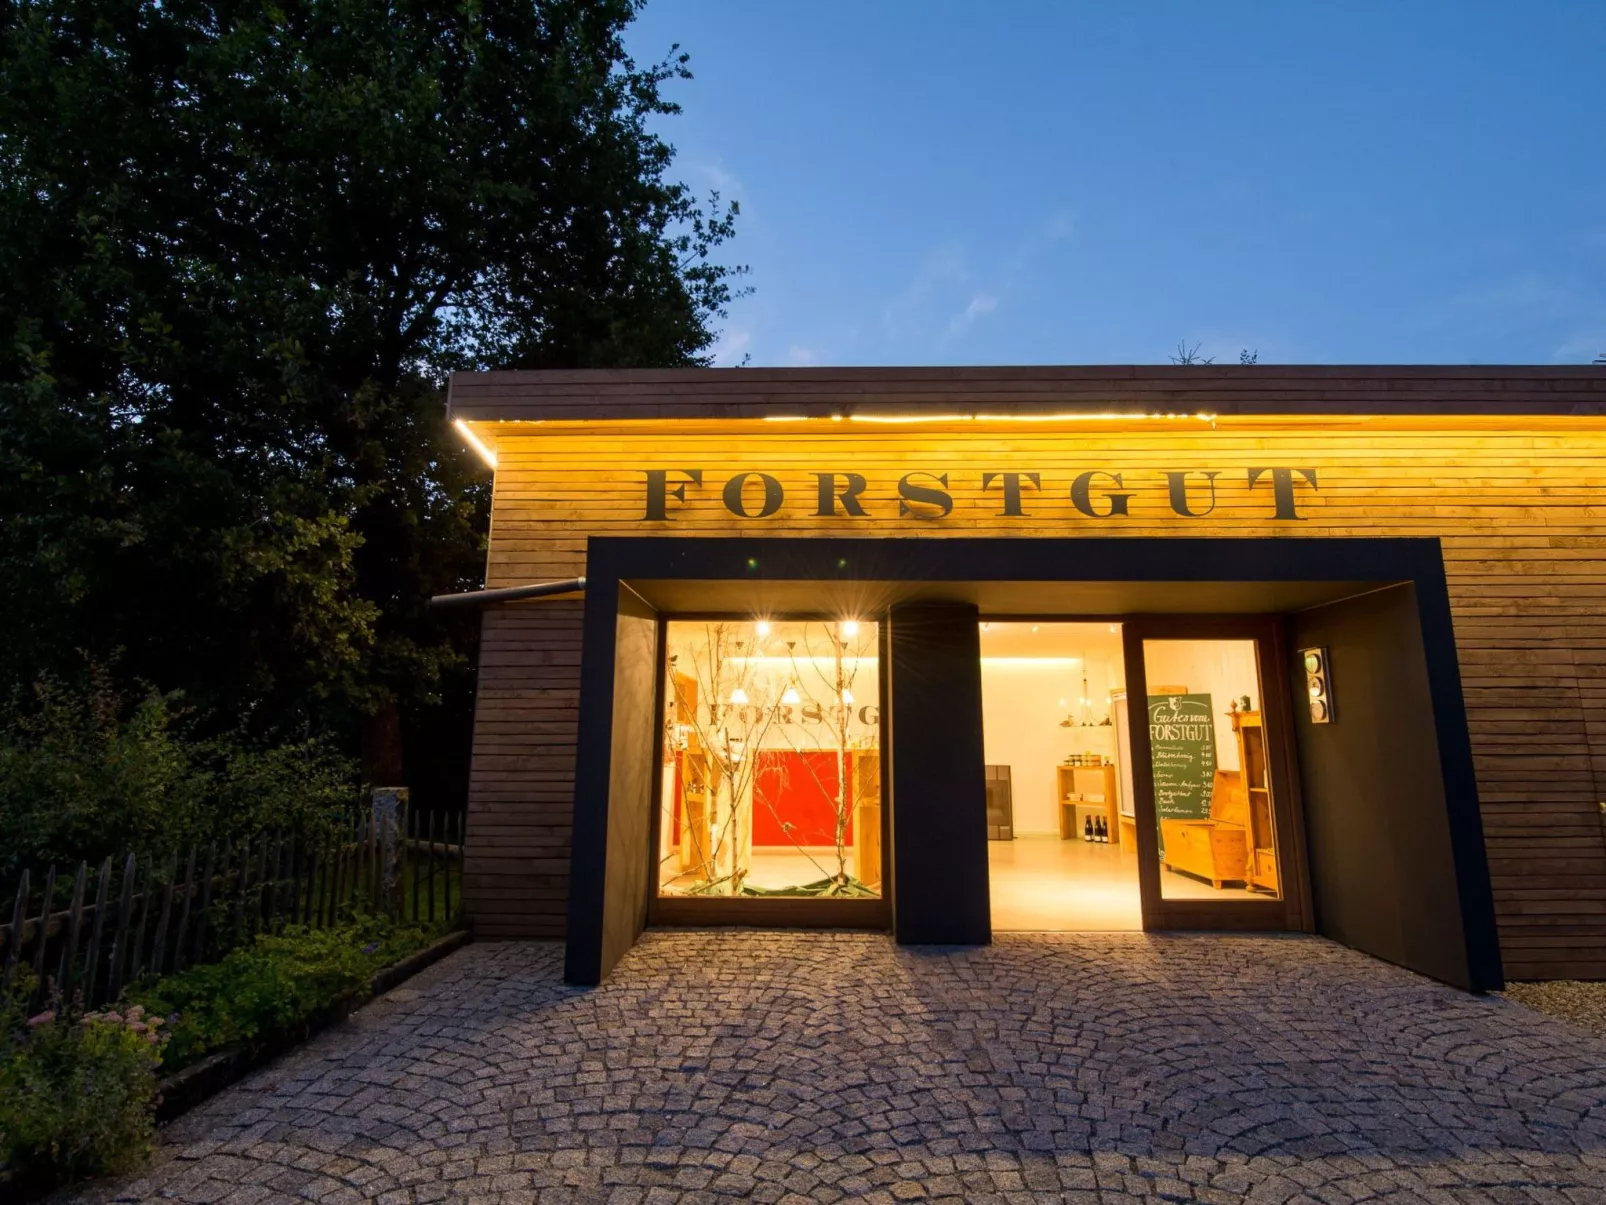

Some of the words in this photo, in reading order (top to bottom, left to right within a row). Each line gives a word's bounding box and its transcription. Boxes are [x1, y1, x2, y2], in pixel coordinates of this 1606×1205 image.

[643, 467, 1317, 521] FORSTGUT
[1153, 706, 1189, 723] Gutes
[1190, 714, 1210, 723] vom
[1150, 723, 1212, 741] FORSTGUT
